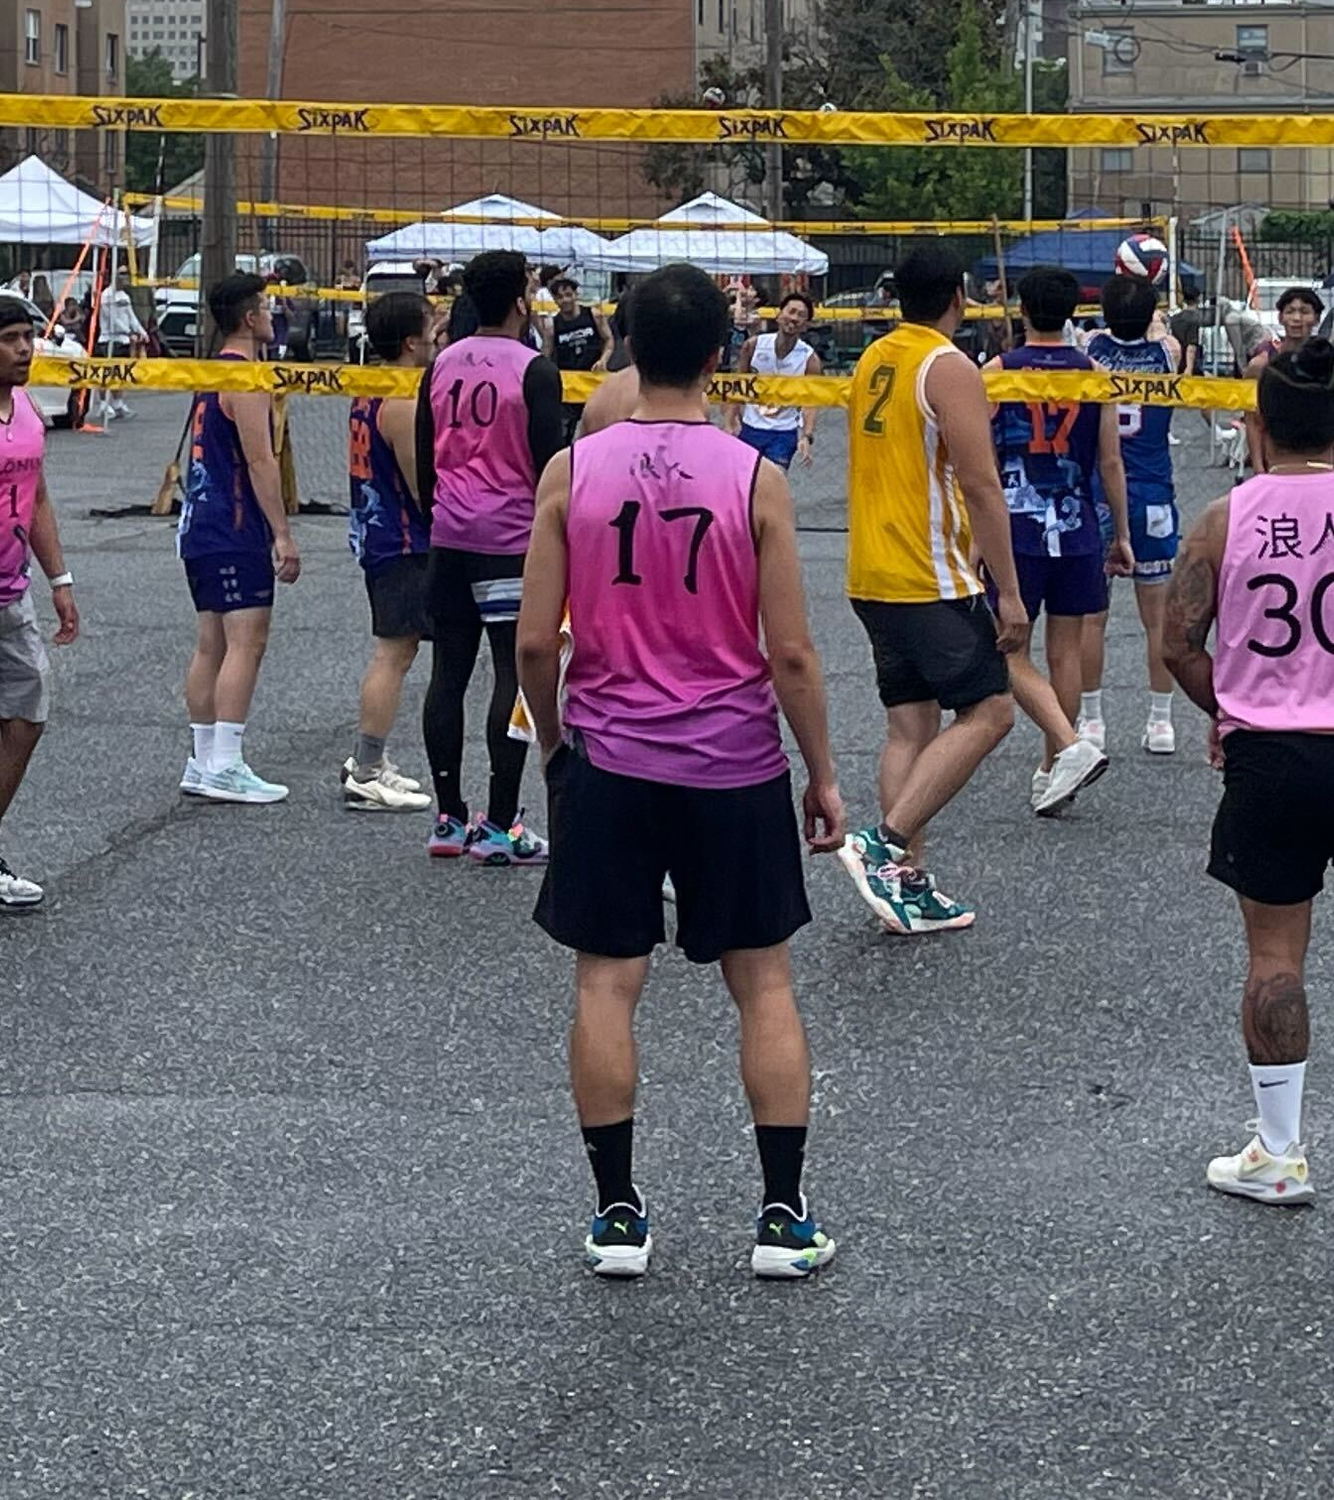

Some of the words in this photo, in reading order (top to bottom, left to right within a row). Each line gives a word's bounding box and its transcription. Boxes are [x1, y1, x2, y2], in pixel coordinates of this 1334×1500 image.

[448, 379, 498, 429] 10
[863, 365, 897, 435] 2
[1025, 401, 1082, 454] 17
[9, 484, 20, 518] 1
[608, 500, 714, 595] 17
